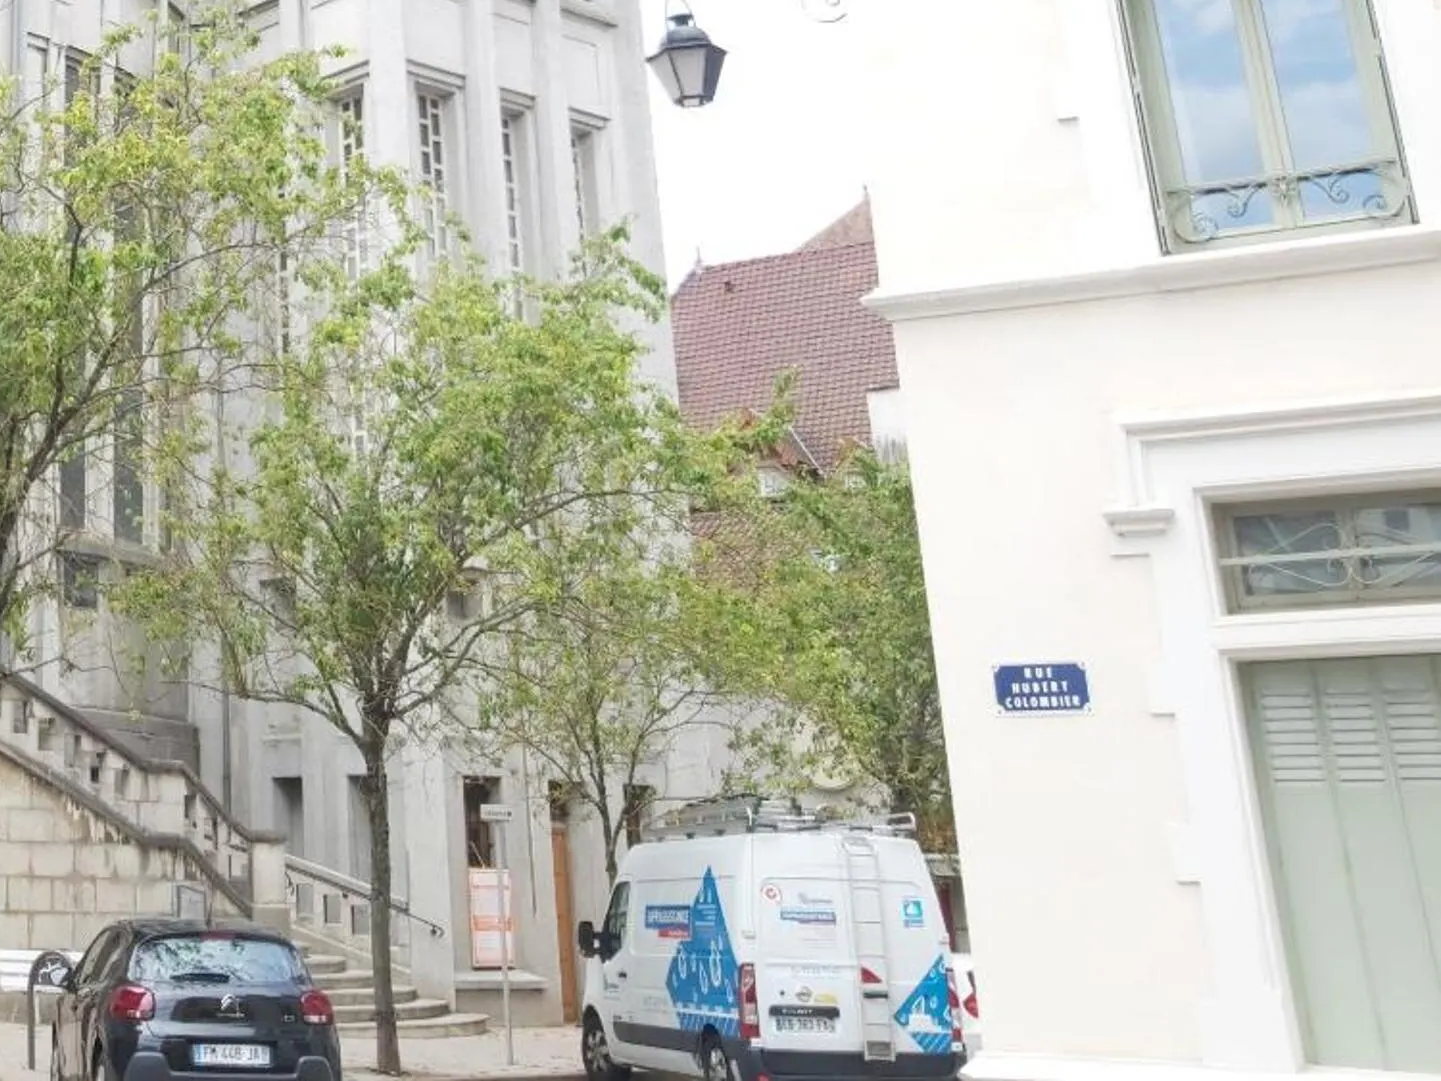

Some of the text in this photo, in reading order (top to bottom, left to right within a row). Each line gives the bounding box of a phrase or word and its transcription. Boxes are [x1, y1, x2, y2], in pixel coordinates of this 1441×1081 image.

[1023, 667, 1052, 679] RUE
[1011, 681, 1068, 694] HUBERT
[1004, 694, 1081, 709] COLOMBIER
